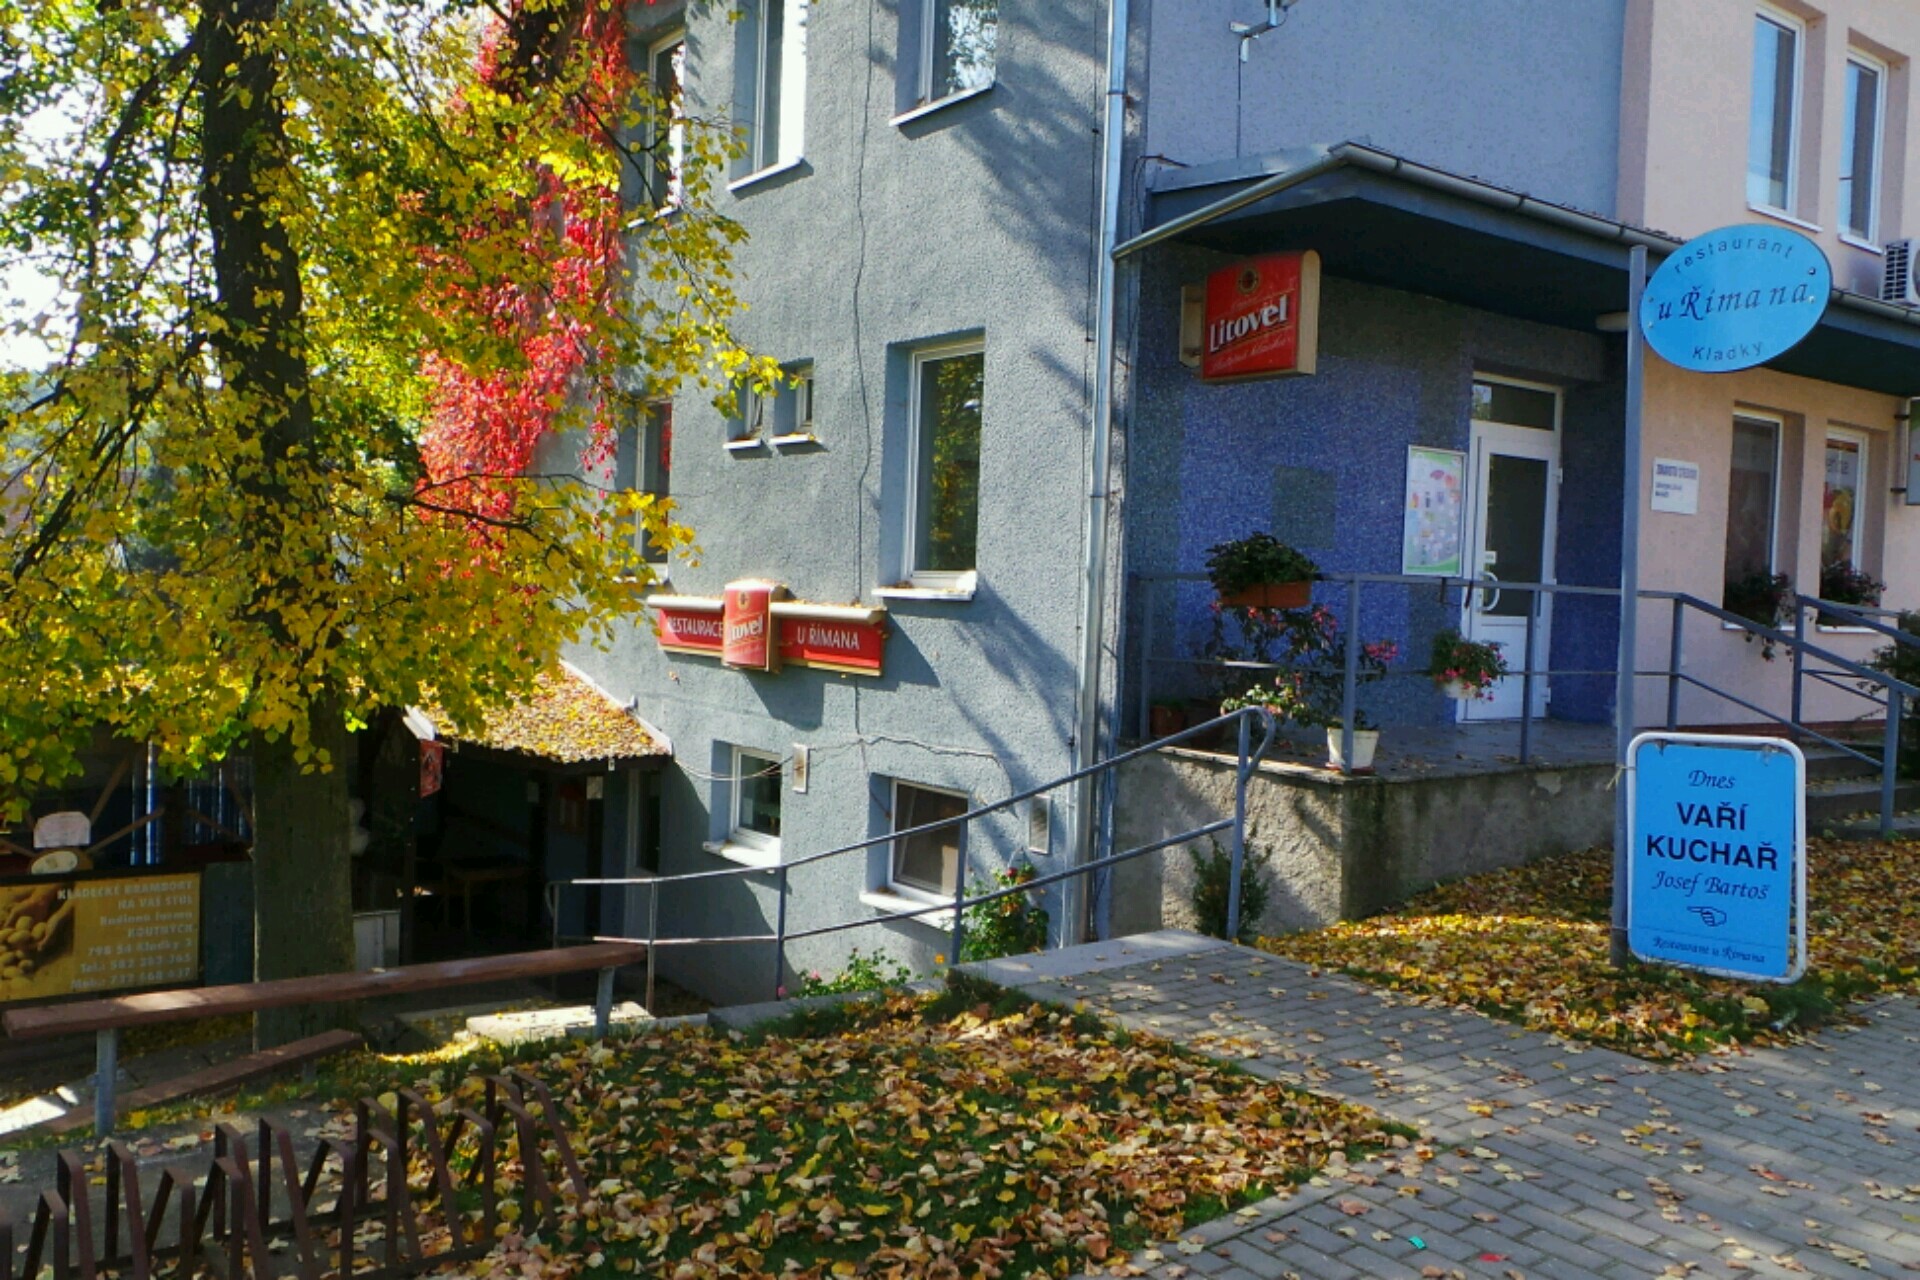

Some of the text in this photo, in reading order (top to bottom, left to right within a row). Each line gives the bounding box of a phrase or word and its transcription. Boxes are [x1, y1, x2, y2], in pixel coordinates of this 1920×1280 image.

[1674, 238, 1794, 274] restaurant
[1209, 294, 1288, 353] Litovel
[1658, 302, 1672, 321] u
[1692, 341, 1764, 361] Kladky
[797, 623, 861, 650] U ŘÍMANA
[1688, 769, 1736, 789] Dnes
[1676, 801, 1749, 831] VAŘÍ
[1646, 834, 1778, 871] KUCHAŘ
[1651, 870, 1771, 900] Josef Bartoš
